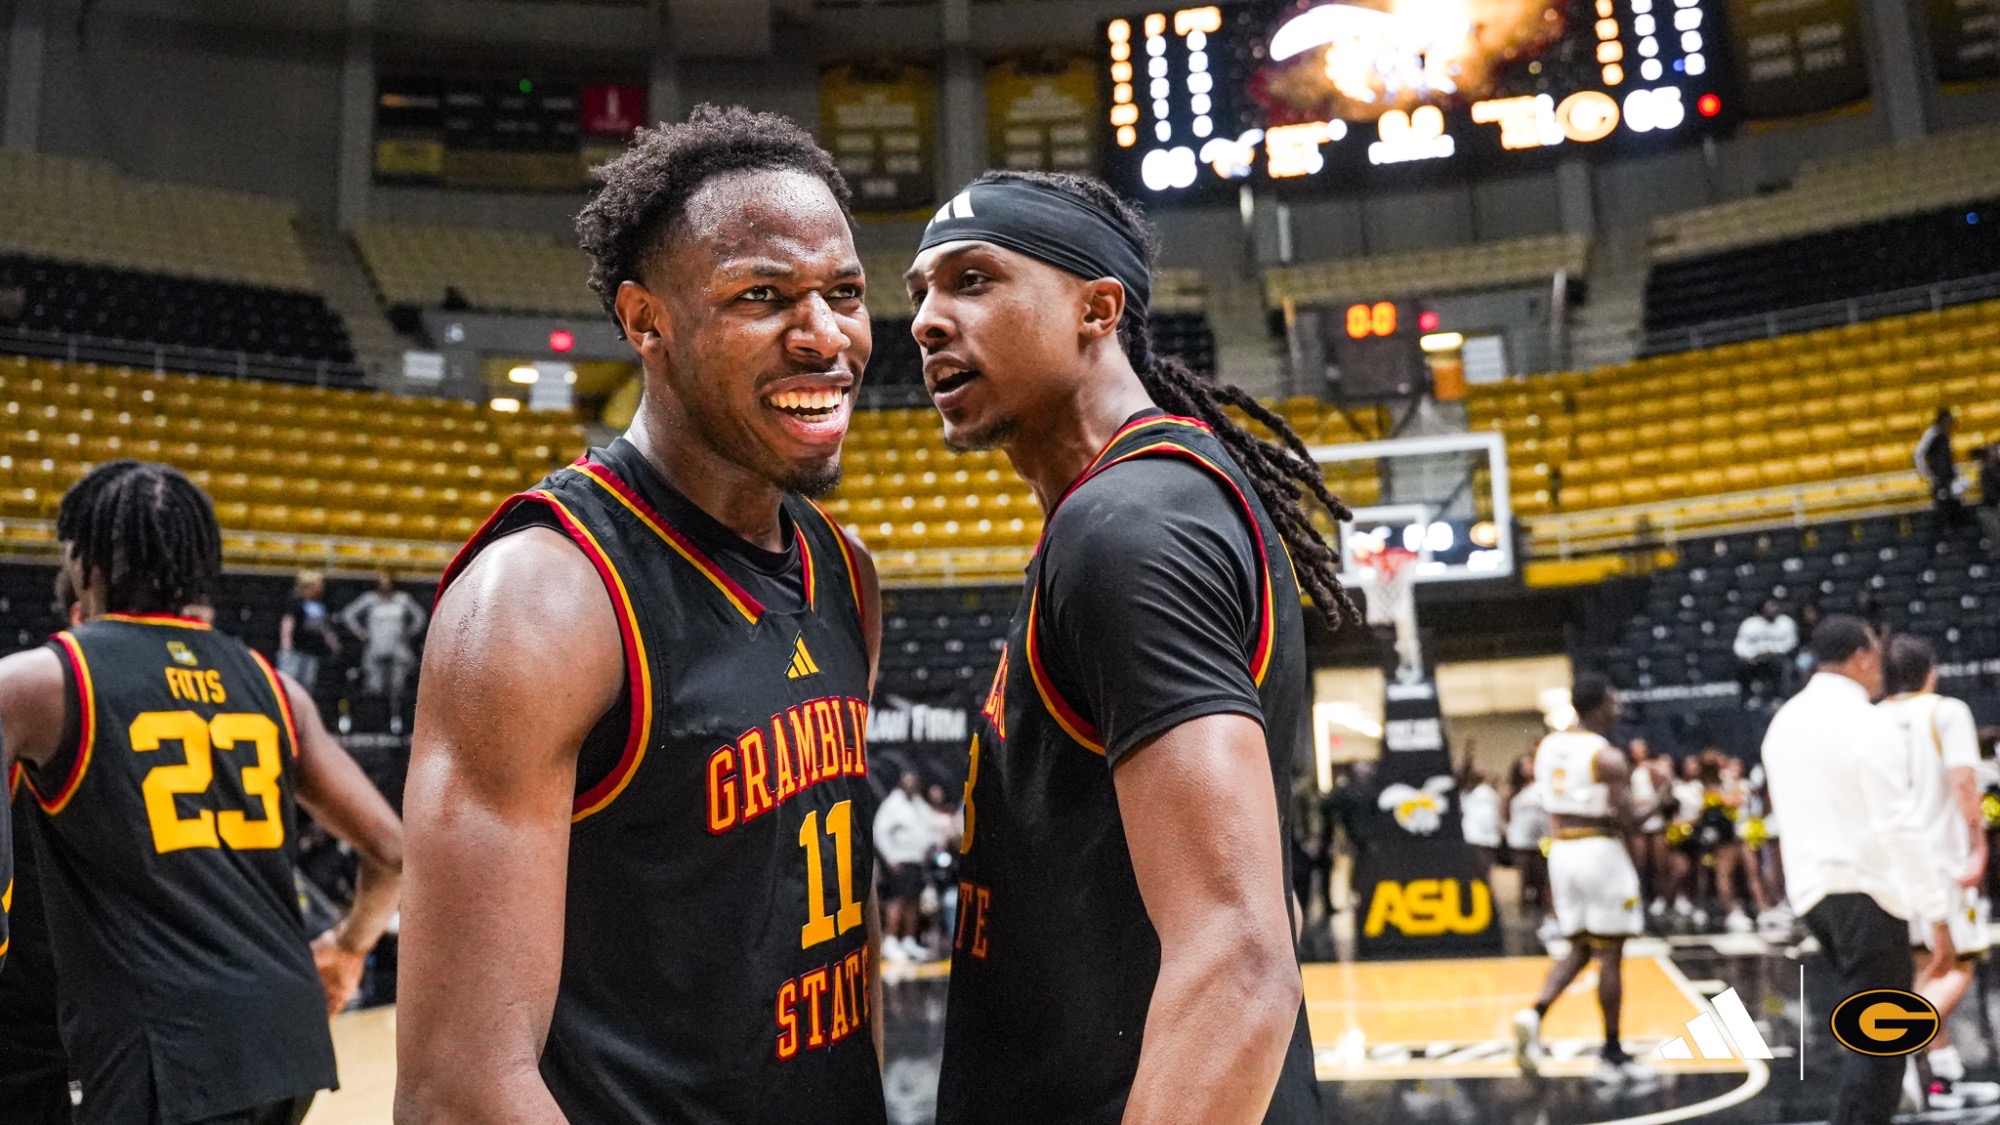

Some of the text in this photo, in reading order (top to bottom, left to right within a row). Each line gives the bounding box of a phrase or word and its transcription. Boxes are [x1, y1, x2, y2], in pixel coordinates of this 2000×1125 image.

[165, 665, 227, 704] FITTS
[129, 711, 285, 854] 23
[799, 799, 862, 950] 11
[1363, 878, 1494, 938] ASU
